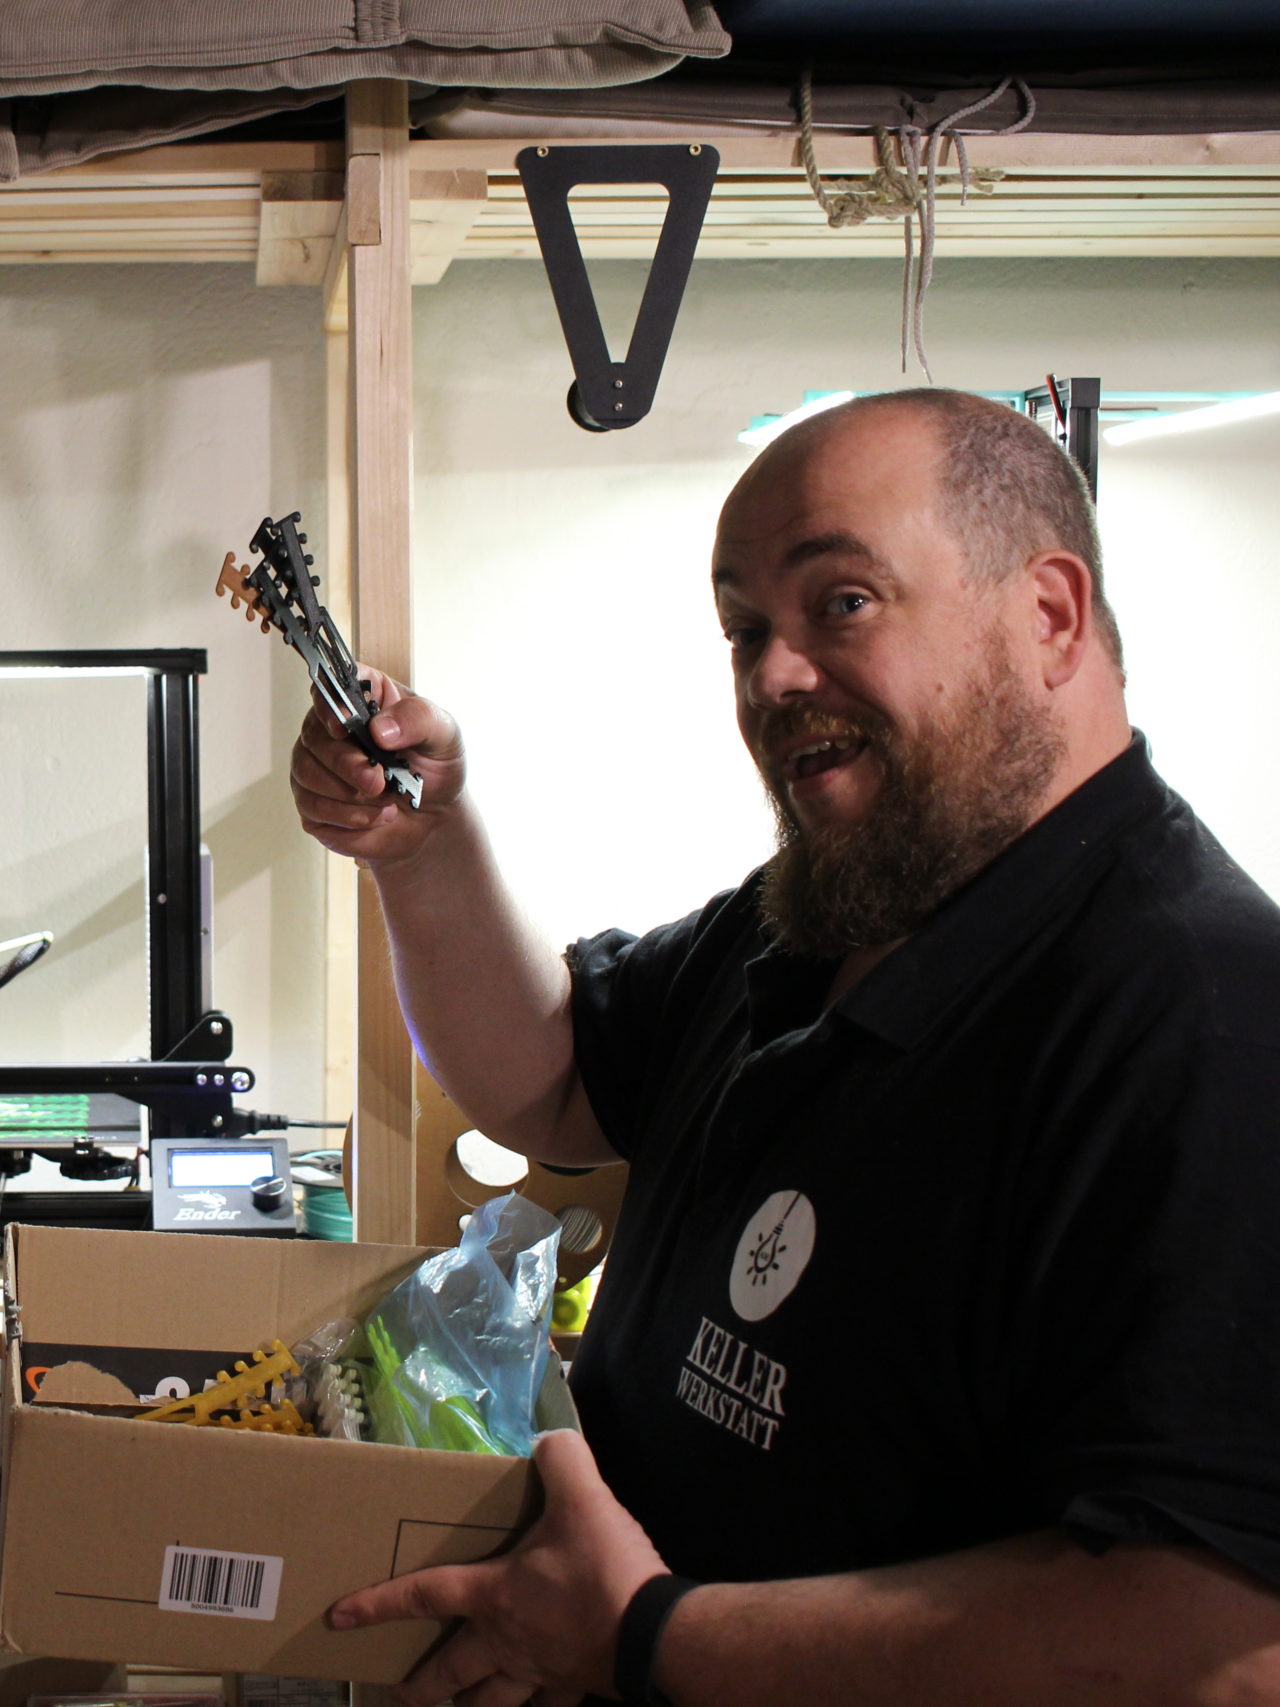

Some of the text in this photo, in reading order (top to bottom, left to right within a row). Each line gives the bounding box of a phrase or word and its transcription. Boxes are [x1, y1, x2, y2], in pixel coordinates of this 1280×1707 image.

[173, 1207, 242, 1221] Ender
[675, 1365, 780, 1451] WERKSTATT
[685, 1315, 787, 1417] KELLER
